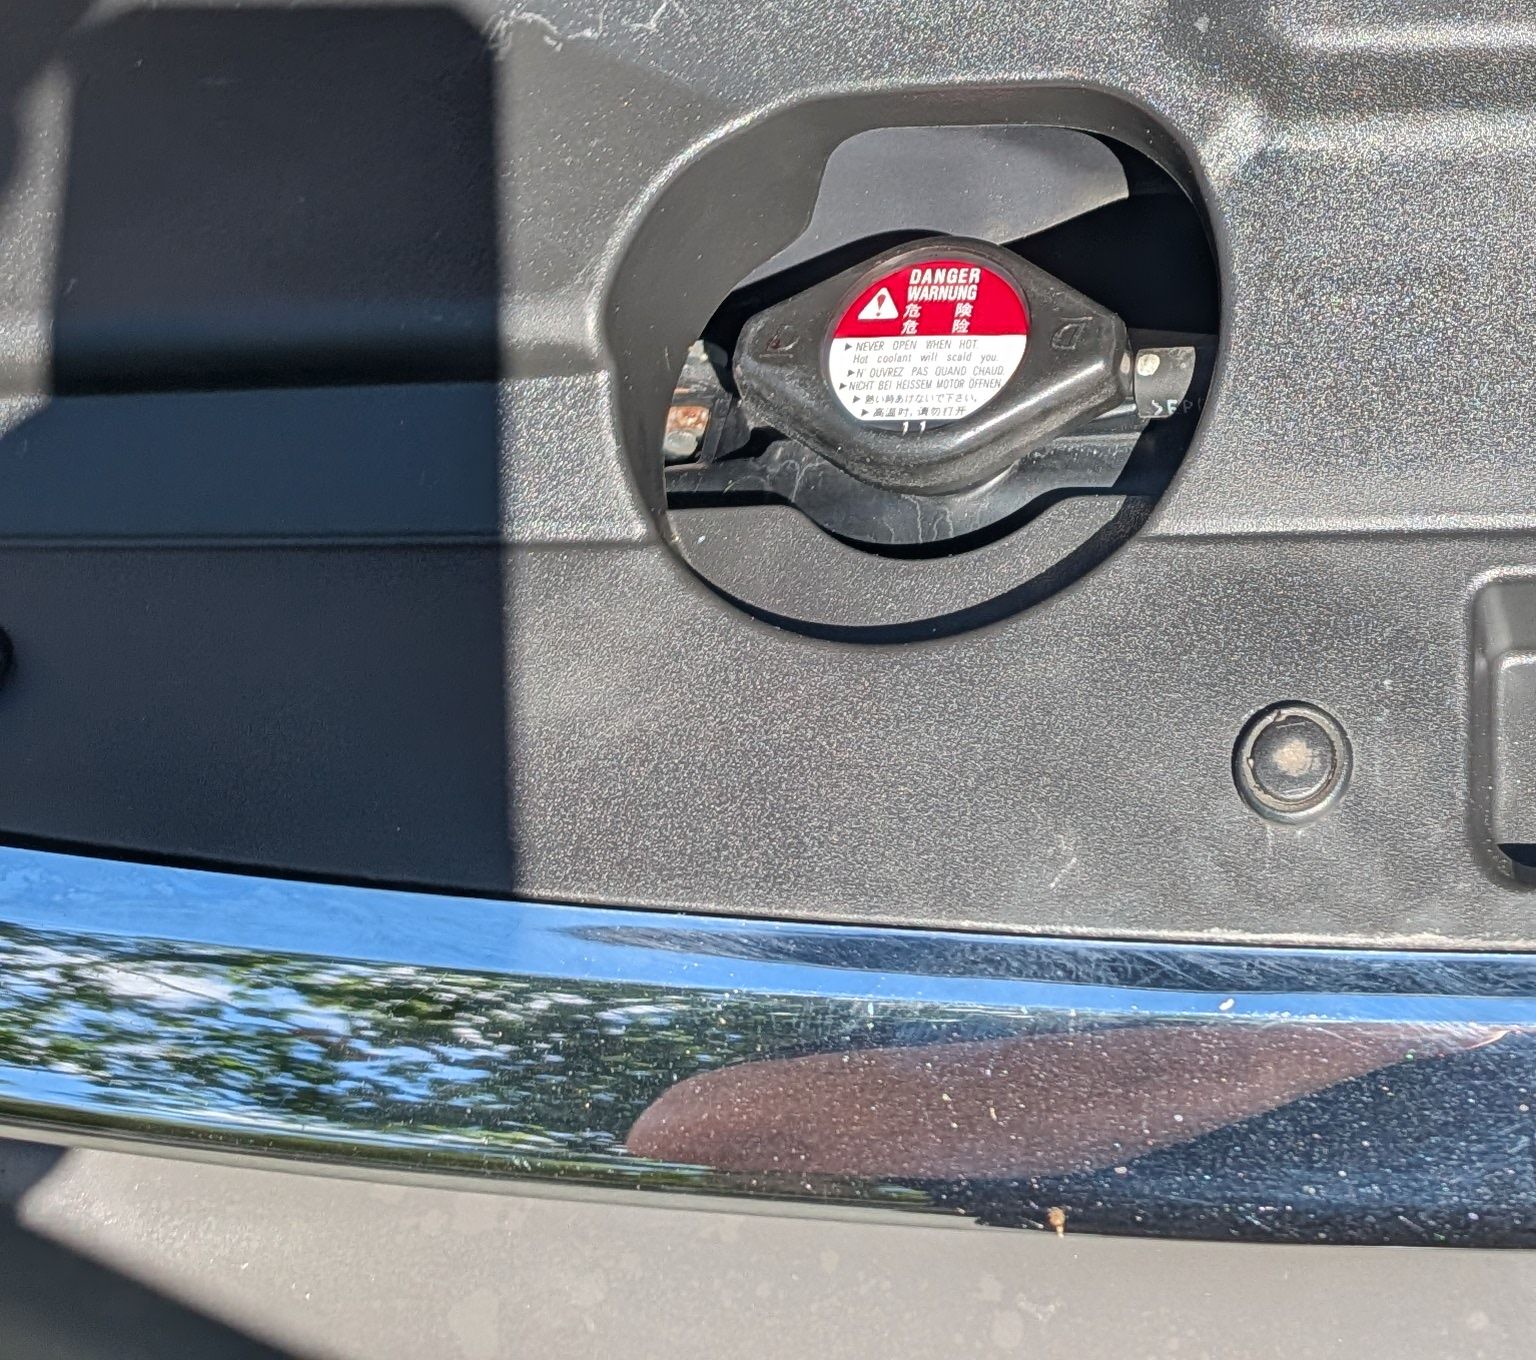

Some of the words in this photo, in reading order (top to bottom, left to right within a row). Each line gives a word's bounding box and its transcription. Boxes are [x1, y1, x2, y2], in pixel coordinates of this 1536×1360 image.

[910, 267, 981, 285] DANGER
[906, 284, 977, 302] WARNUNG
[856, 340, 885, 352] NEVER
[892, 339, 918, 351] OPEN
[926, 339, 952, 350] WHEN
[853, 353, 869, 364] Hot
[877, 353, 912, 363] coolant
[920, 351, 938, 362] will
[947, 351, 973, 362] scald
[869, 366, 905, 378] OUVREZ
[911, 366, 929, 377] PAS
[934, 365, 967, 377] QUAND
[878, 379, 892, 390] BEI
[895, 378, 933, 390] HEISSEM
[936, 378, 966, 389] MOTOR
